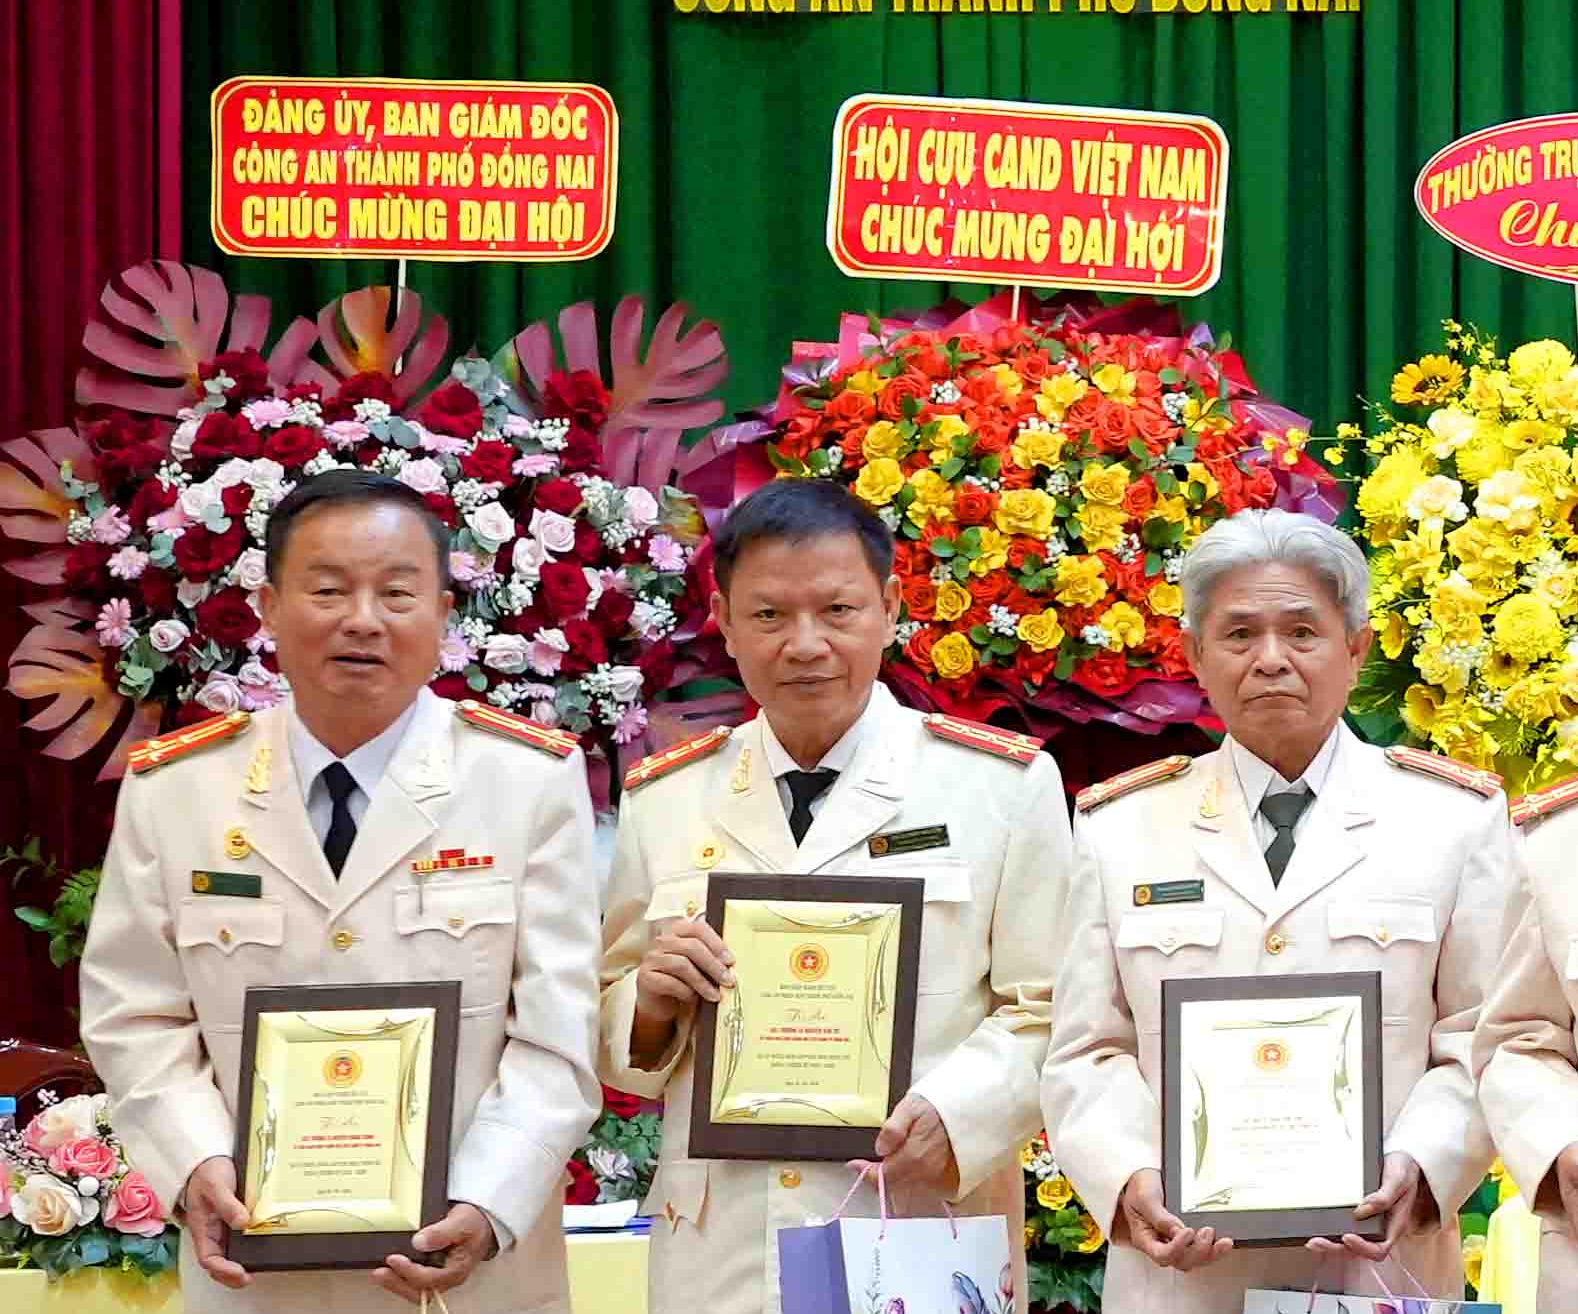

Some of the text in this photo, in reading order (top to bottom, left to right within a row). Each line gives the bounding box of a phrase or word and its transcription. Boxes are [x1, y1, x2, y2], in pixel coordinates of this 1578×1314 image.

[243, 89, 588, 142] ĐẢNG ỦY, BAN GIÁM ĐỐC
[232, 141, 595, 190] CÔNG AN THÀNH PHỐ ĐỒNG NAI
[854, 115, 910, 195] HỘI
[918, 128, 977, 199] CỰU
[1071, 130, 1132, 209] VIỆT
[1138, 144, 1206, 202] NAM
[1427, 143, 1532, 214] THƯỜNG
[241, 190, 585, 249] CHÚC MỪNG ĐẠI HỘI
[860, 194, 1185, 283] CHÚC MỪNG ĐẠI HỘI
